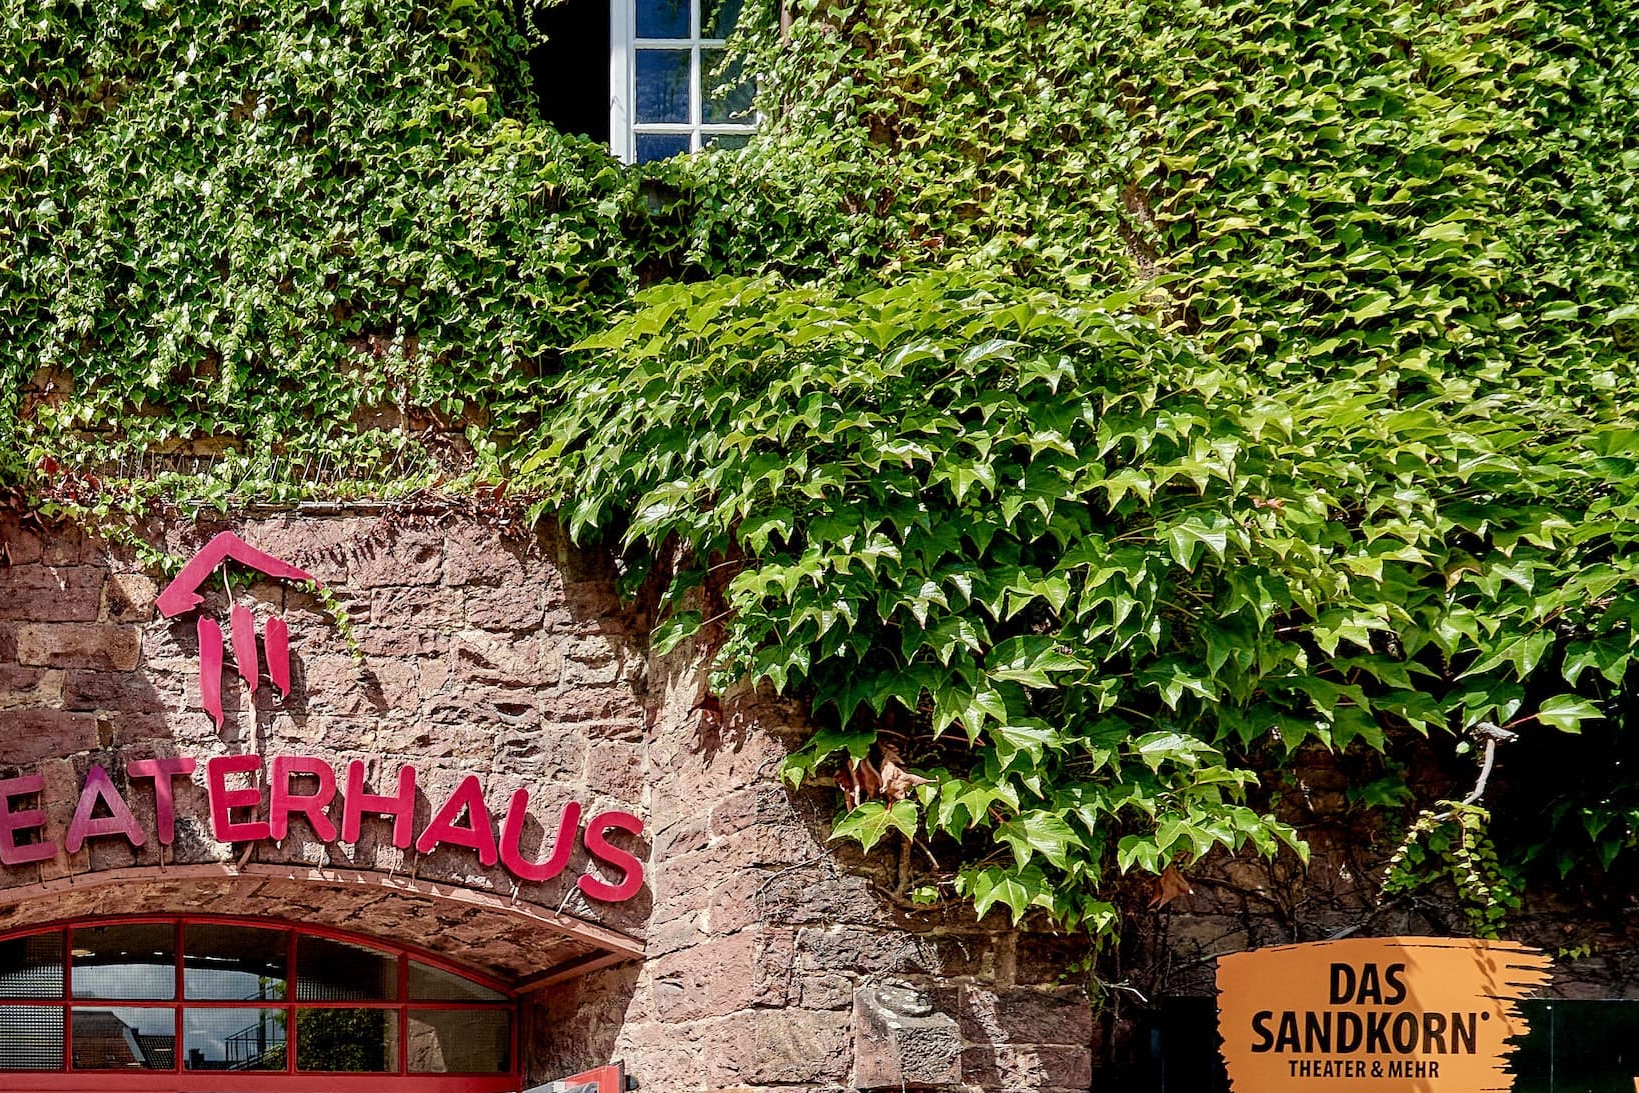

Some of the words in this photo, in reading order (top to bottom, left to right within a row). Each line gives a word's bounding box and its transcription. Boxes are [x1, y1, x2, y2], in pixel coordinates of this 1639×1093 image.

[1329, 962, 1407, 1006] DAS
[1250, 1010, 1477, 1055] SANDKORN
[1288, 1060, 1366, 1079] THEATER
[1370, 1062, 1384, 1079] &
[1387, 1061, 1440, 1079] MEHR
